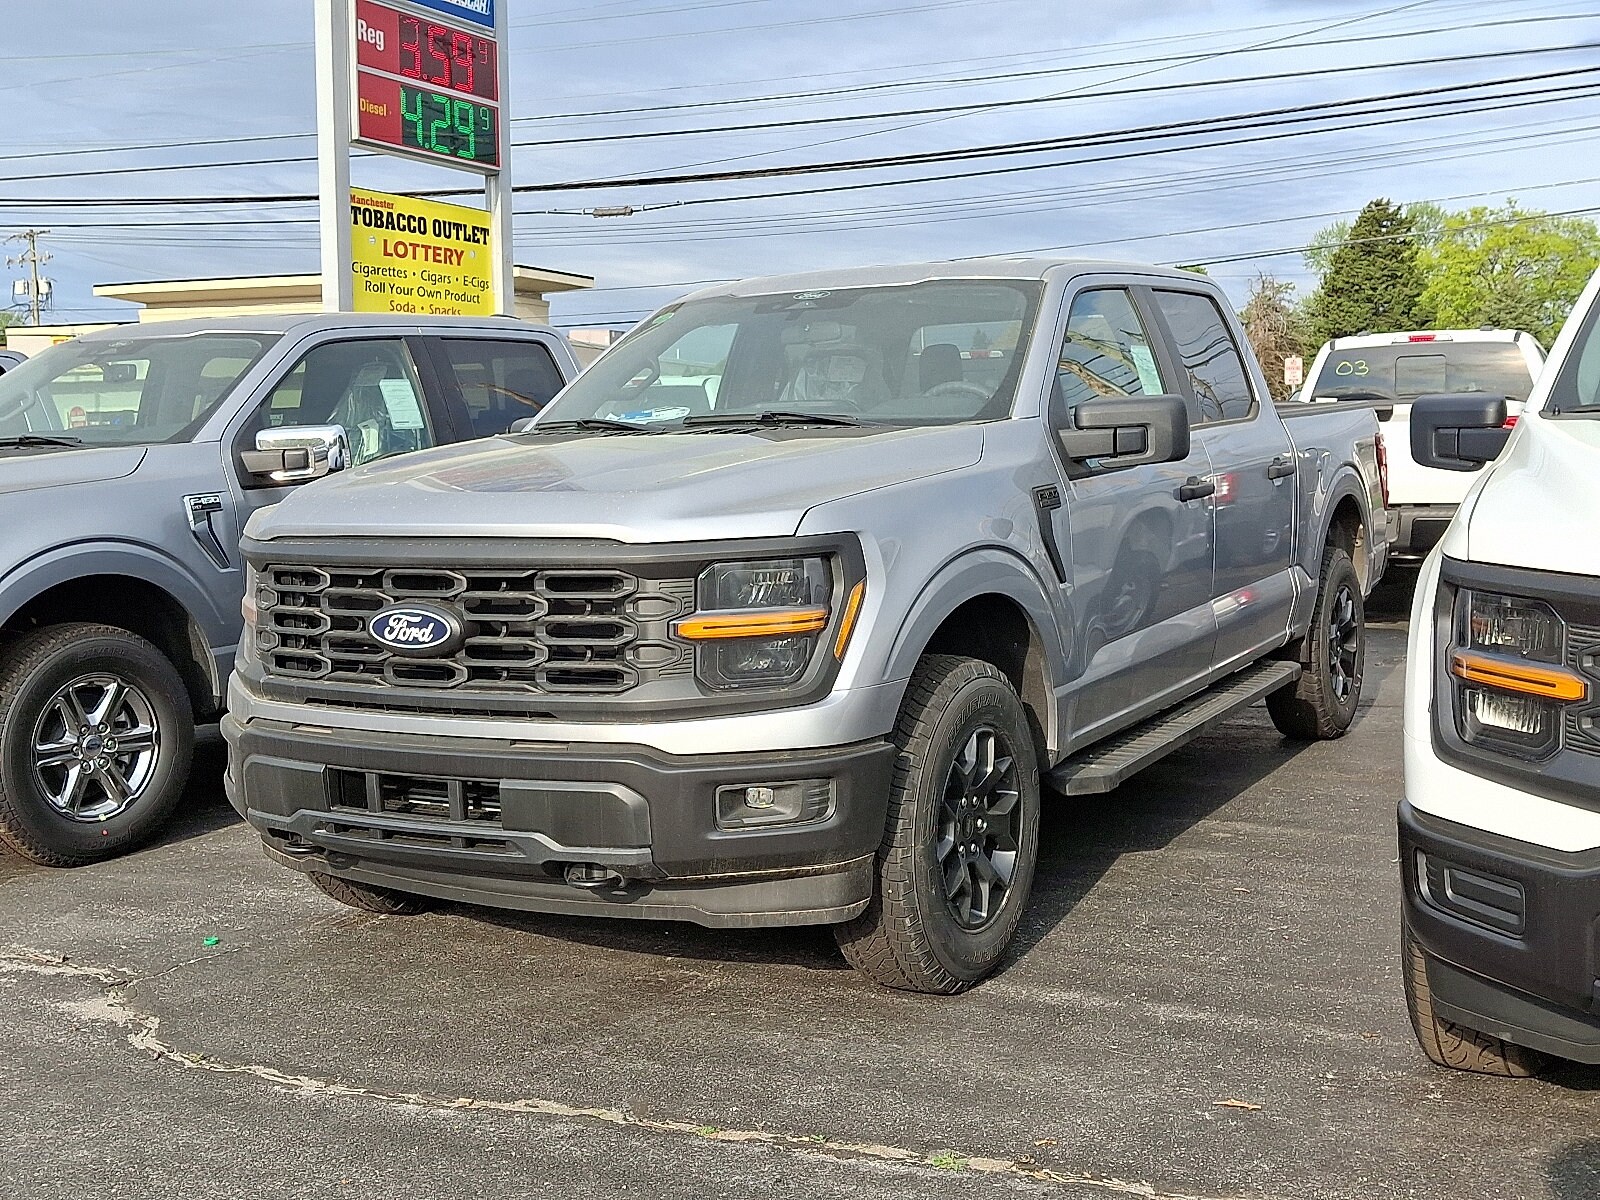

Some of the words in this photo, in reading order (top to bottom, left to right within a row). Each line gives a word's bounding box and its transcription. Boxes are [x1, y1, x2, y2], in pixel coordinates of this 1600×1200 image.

[357, 19, 385, 51] Reg
[359, 97, 387, 117] Diesel
[400, 87, 475, 160] 4.29
[350, 194, 395, 210] Manchester
[351, 205, 428, 236] TOBACCO
[432, 218, 490, 246] OUTLET
[383, 238, 465, 267] LOTTERY
[351, 261, 408, 279] Cigarettes
[420, 269, 452, 286] Cigars
[463, 275, 490, 292] E-Cigs
[365, 280, 386, 294] Roll
[388, 283, 414, 297] Your
[417, 286, 442, 300] Own
[445, 289, 481, 305] Product
[389, 300, 416, 314] Soda
[429, 303, 461, 316] Snacks
[1335, 360, 1370, 377] 03
[384, 613, 436, 643] Ford
